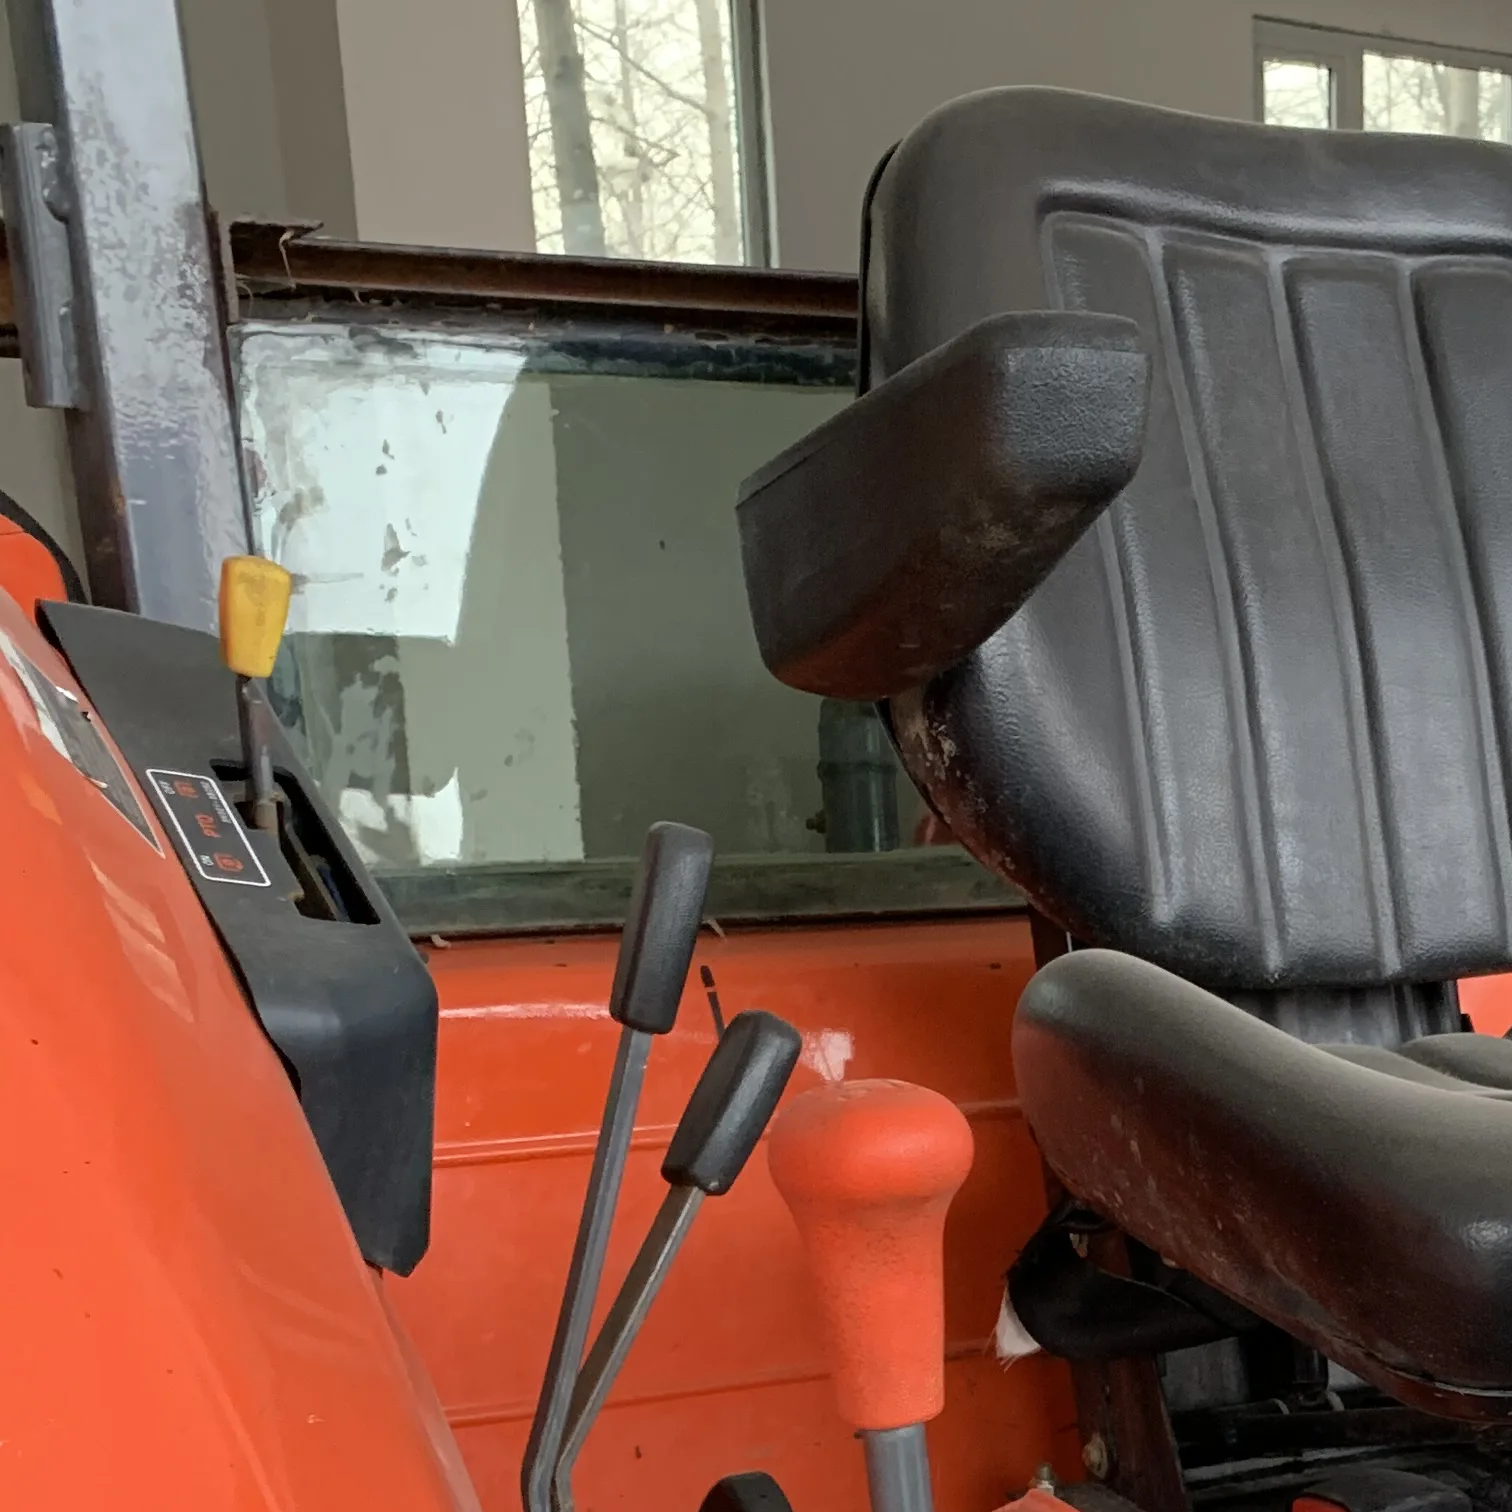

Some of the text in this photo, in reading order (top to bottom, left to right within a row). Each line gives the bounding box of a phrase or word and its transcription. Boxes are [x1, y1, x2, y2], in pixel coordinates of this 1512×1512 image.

[159, 780, 176, 795] OFF
[195, 813, 221, 838] PTO
[200, 854, 214, 866] ON
